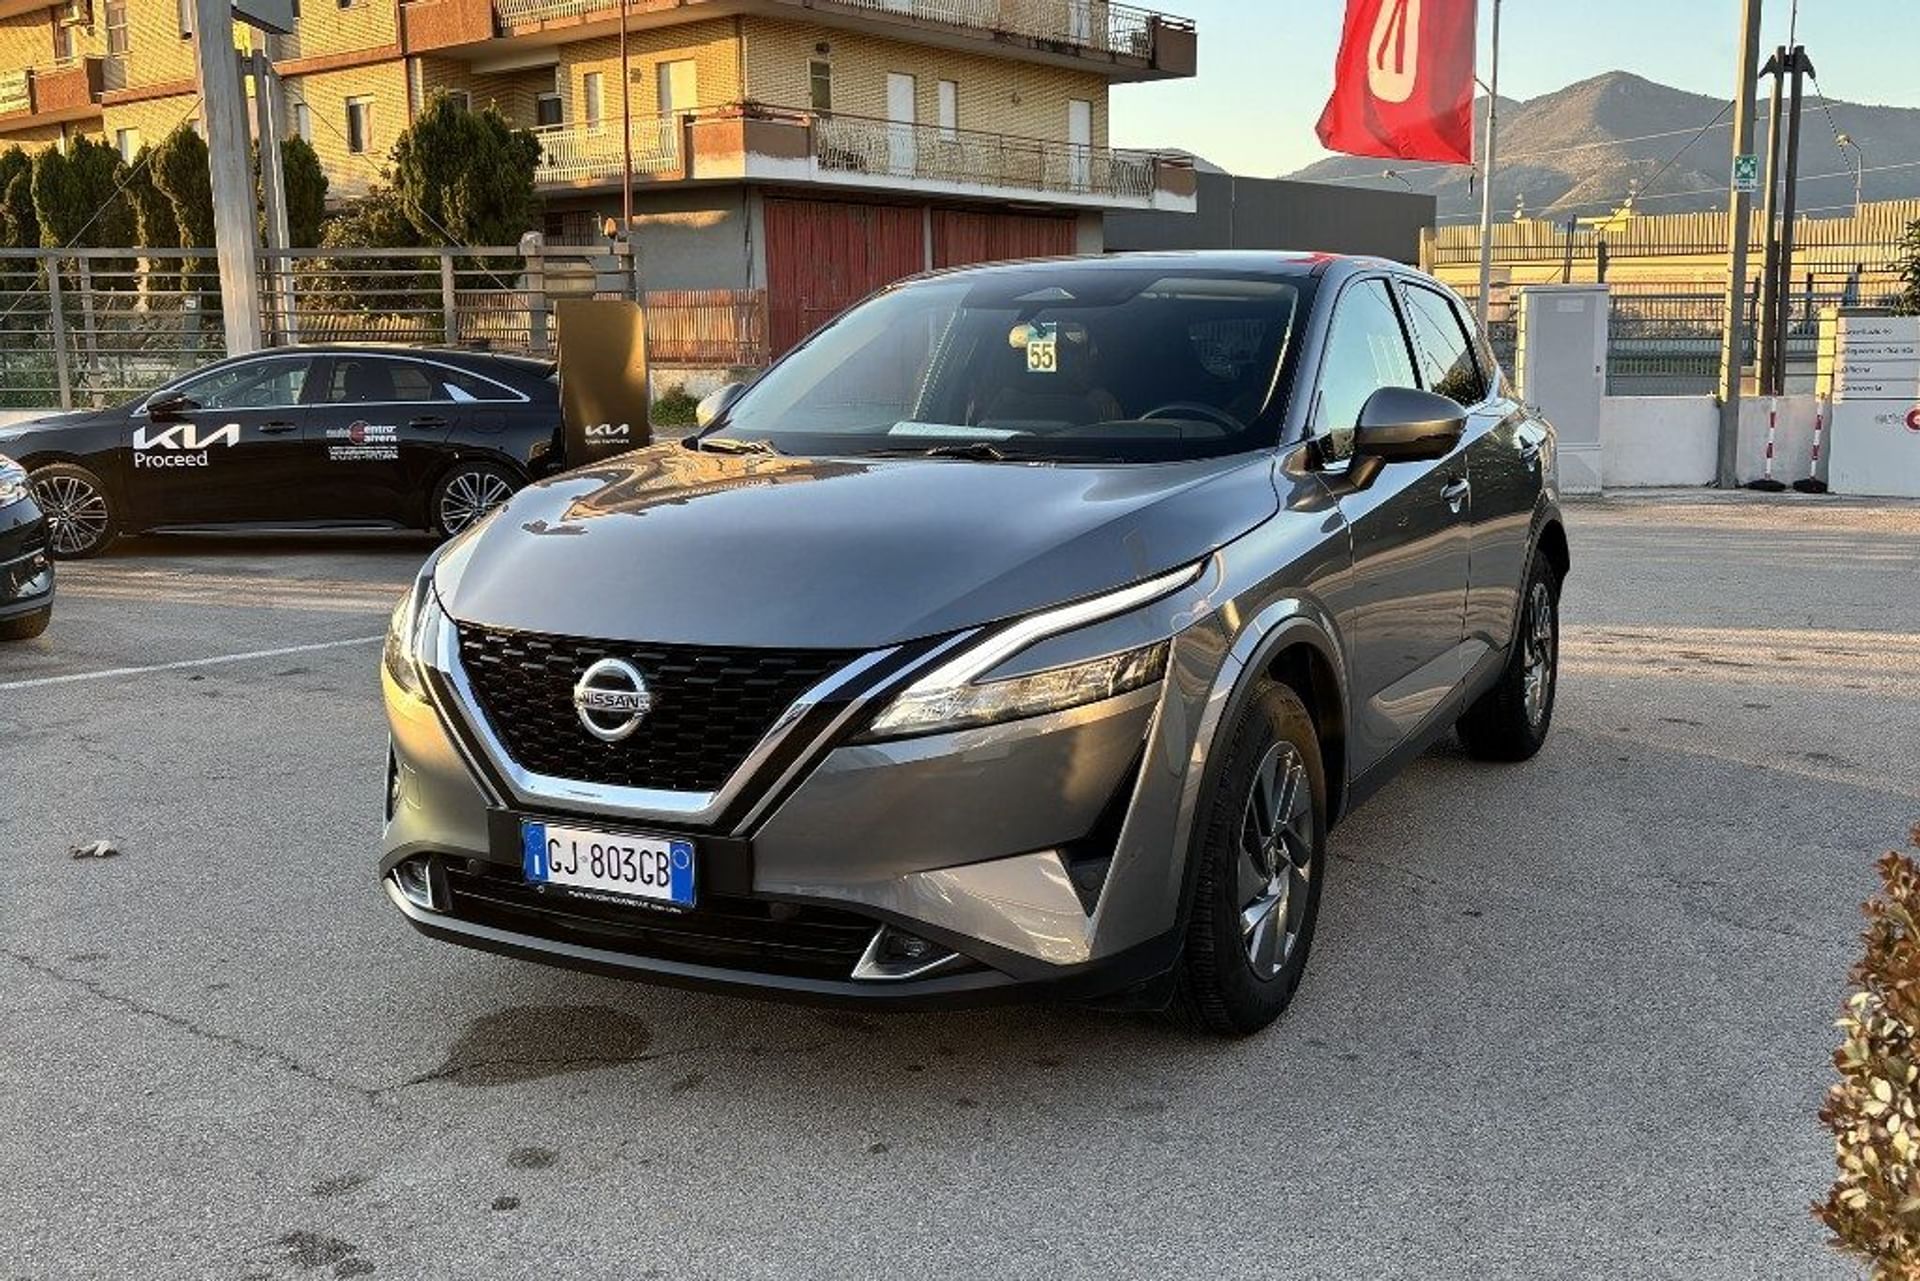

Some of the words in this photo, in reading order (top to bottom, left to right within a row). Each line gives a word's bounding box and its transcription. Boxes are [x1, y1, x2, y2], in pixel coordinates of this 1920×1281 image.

[1031, 343, 1053, 369] 55
[133, 423, 240, 449] KIA
[584, 423, 630, 436] KIA
[134, 450, 209, 468] Proceed
[581, 692, 639, 708] NISSAN
